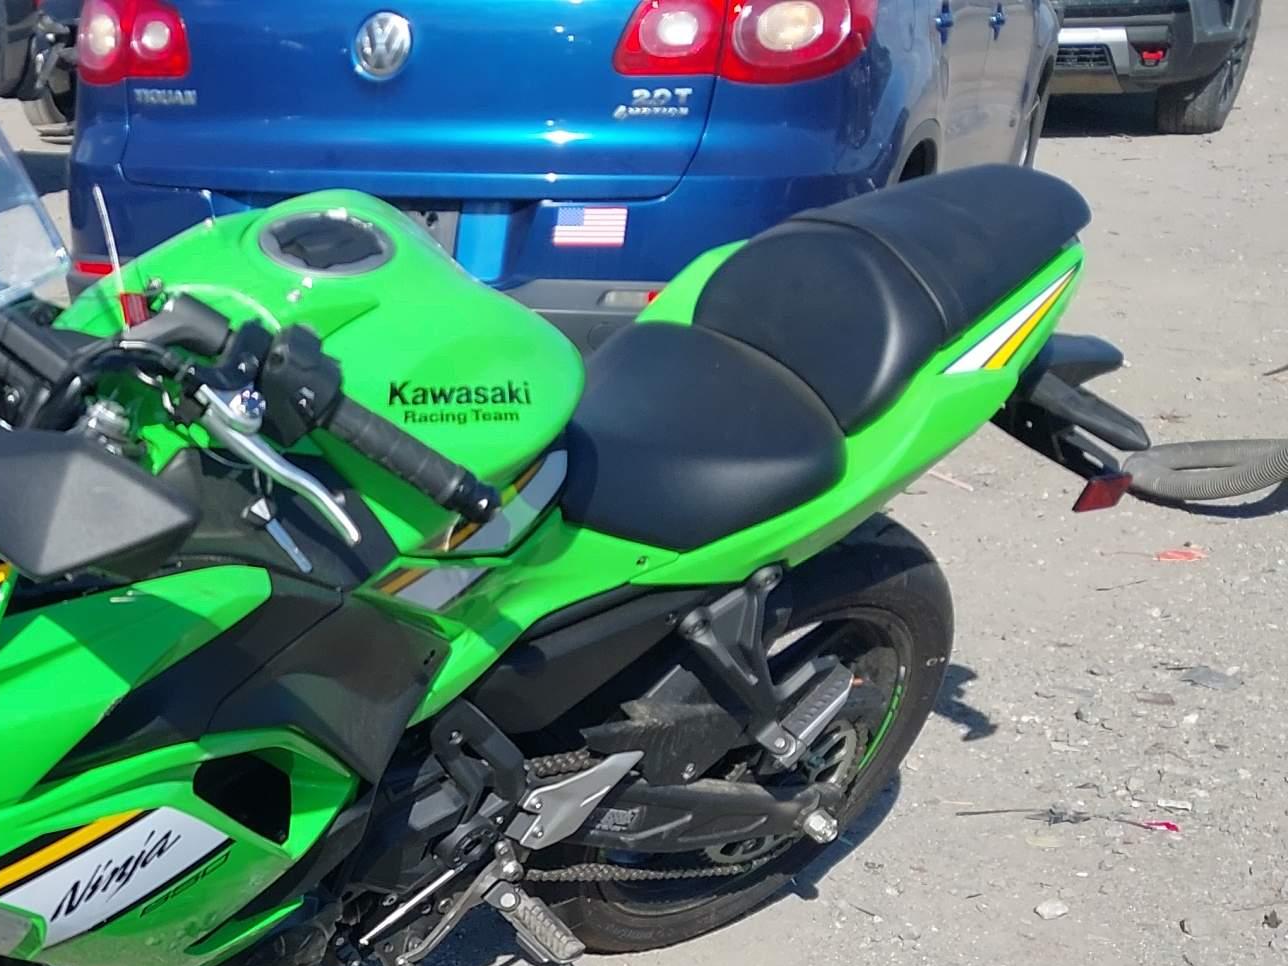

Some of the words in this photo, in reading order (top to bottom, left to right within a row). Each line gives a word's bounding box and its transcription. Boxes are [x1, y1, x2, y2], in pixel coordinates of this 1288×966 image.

[388, 380, 532, 406] Kawasaki
[403, 409, 468, 425] Racing
[471, 408, 521, 422] Team
[50, 830, 182, 922] Ninja
